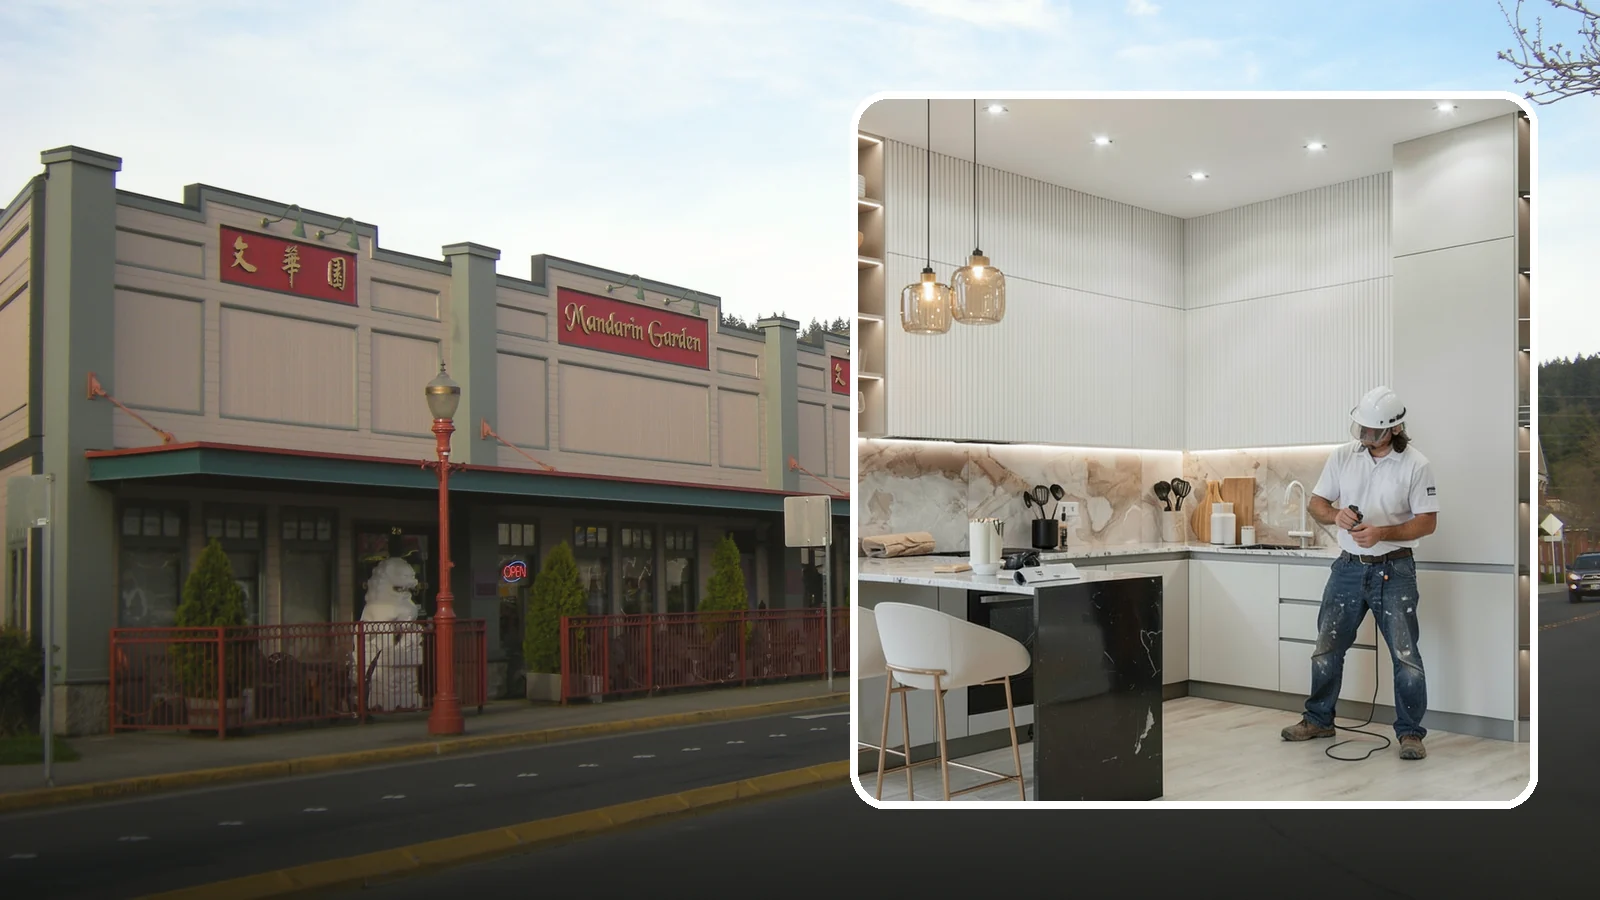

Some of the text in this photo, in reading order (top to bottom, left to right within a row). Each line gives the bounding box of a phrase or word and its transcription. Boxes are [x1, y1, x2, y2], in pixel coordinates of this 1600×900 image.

[230, 235, 347, 291] 文華園
[564, 302, 702, 352] Mandarin Garden
[503, 565, 527, 578] OPEN
